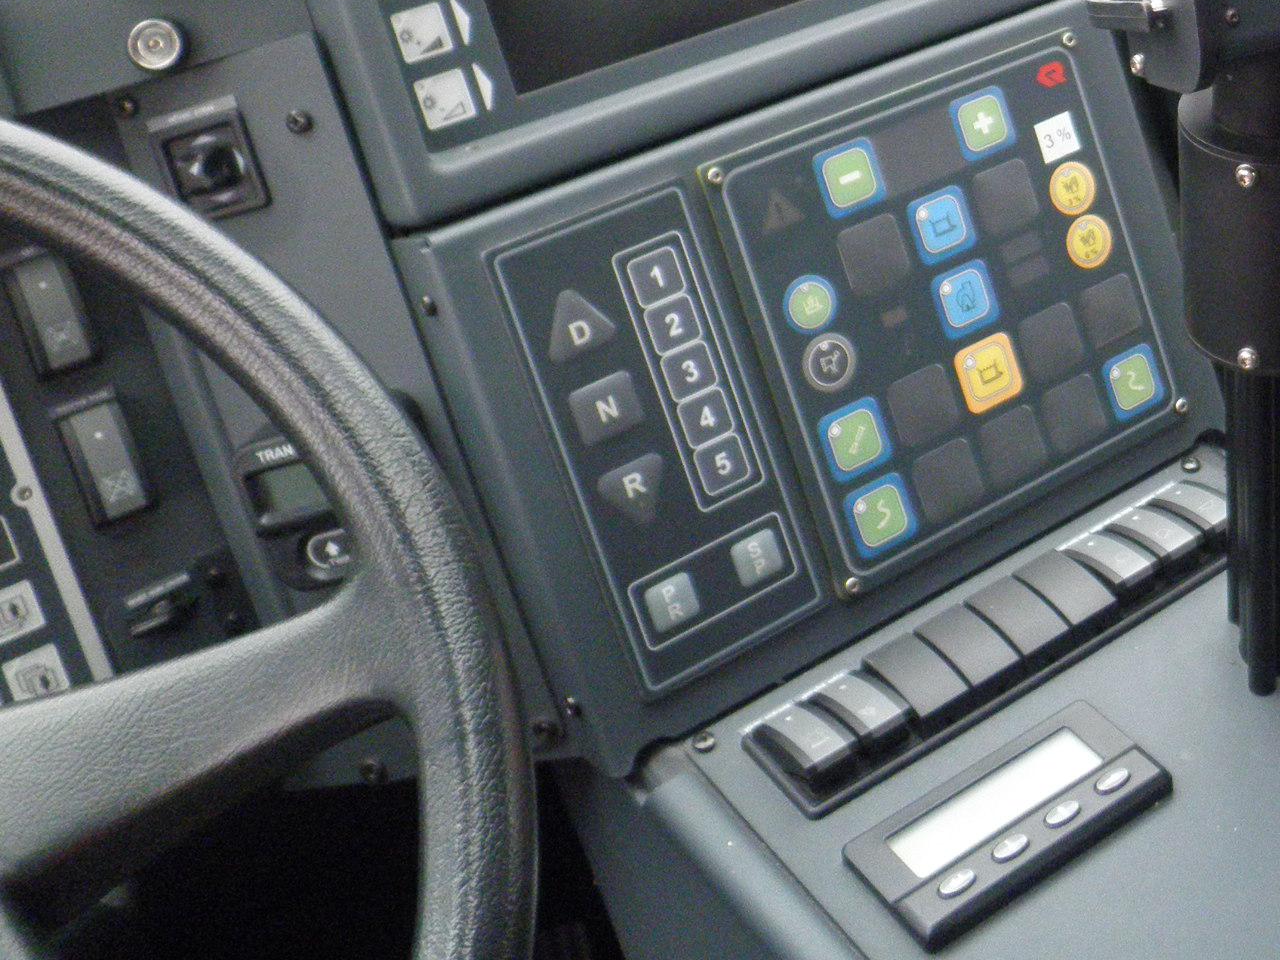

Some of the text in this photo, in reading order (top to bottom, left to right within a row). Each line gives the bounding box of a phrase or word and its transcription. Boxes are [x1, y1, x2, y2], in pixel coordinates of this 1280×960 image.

[649, 265, 665, 288] 1
[567, 319, 592, 346] D
[664, 312, 684, 337] 2
[681, 359, 701, 383] 3
[595, 394, 620, 423] N
[698, 404, 716, 428] 4
[714, 451, 733, 476] 5
[621, 471, 647, 499] R
